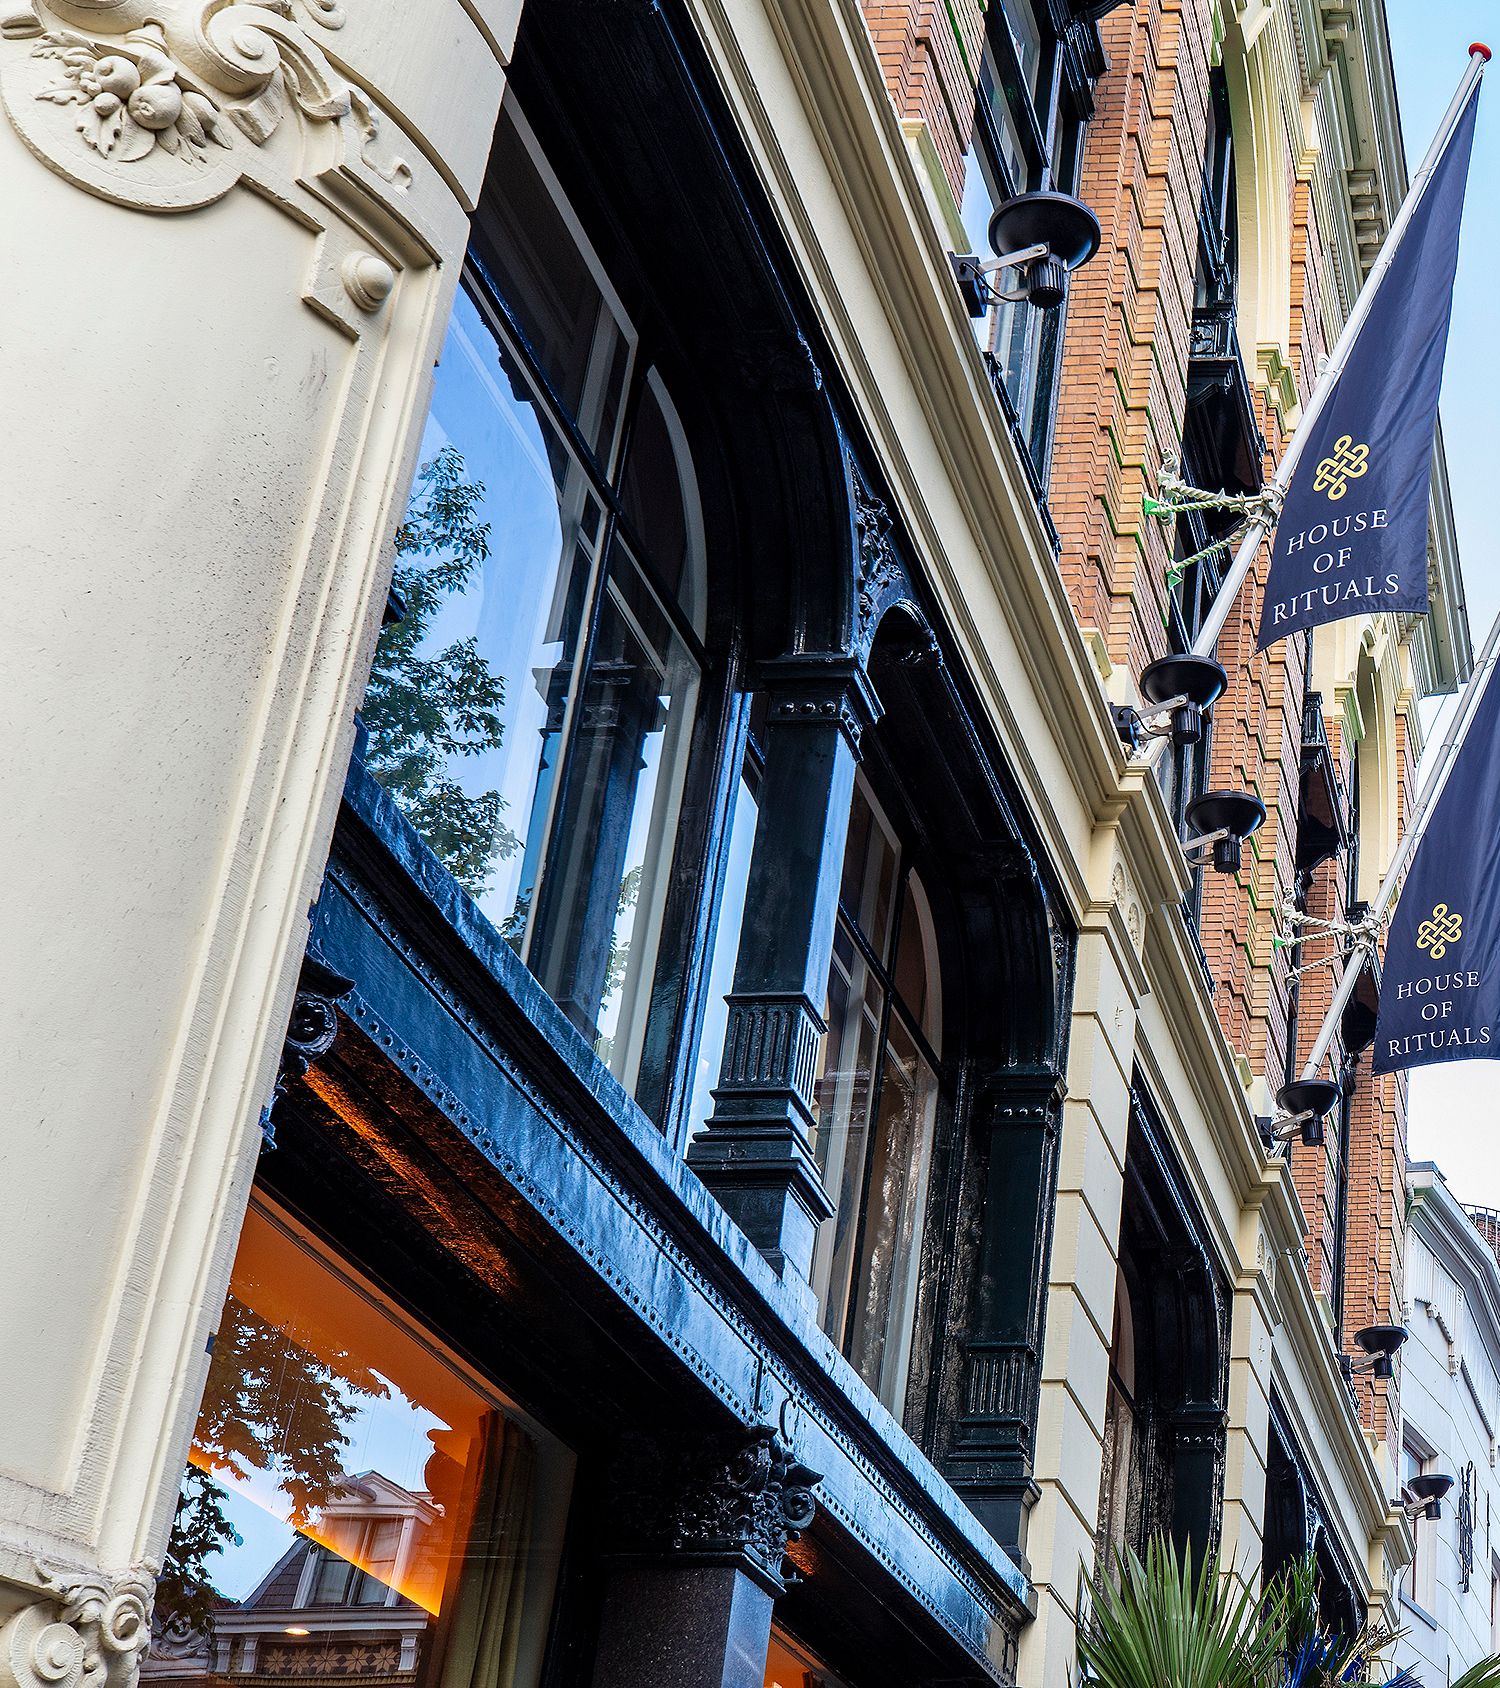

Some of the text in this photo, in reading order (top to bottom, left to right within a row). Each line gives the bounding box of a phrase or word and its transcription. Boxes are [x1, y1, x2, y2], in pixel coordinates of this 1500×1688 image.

[1286, 509, 1389, 555] HOUSE
[1313, 547, 1352, 573] OF
[1272, 574, 1399, 625] RITUALS
[1397, 971, 1480, 1000] HOUSE
[1421, 1001, 1453, 1021] OF
[1388, 1026, 1491, 1057] RITUALS
